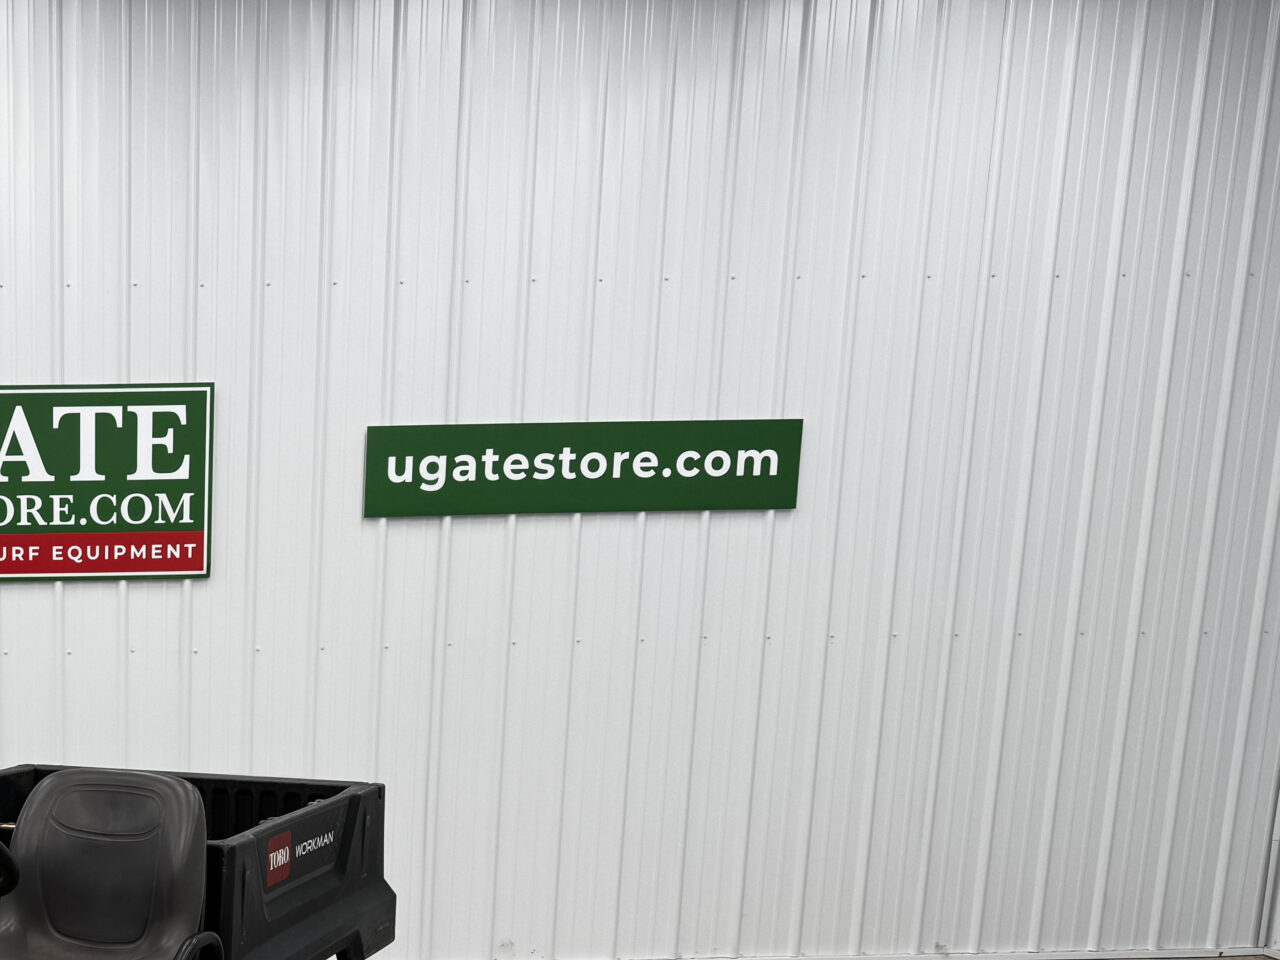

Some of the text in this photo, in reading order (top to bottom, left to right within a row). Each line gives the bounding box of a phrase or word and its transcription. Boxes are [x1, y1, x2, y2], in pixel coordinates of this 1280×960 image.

[387, 447, 779, 492] ugatestore.com
[51, 543, 197, 562] EQUIPMENT
[269, 830, 335, 871] TORO WORKMAN
